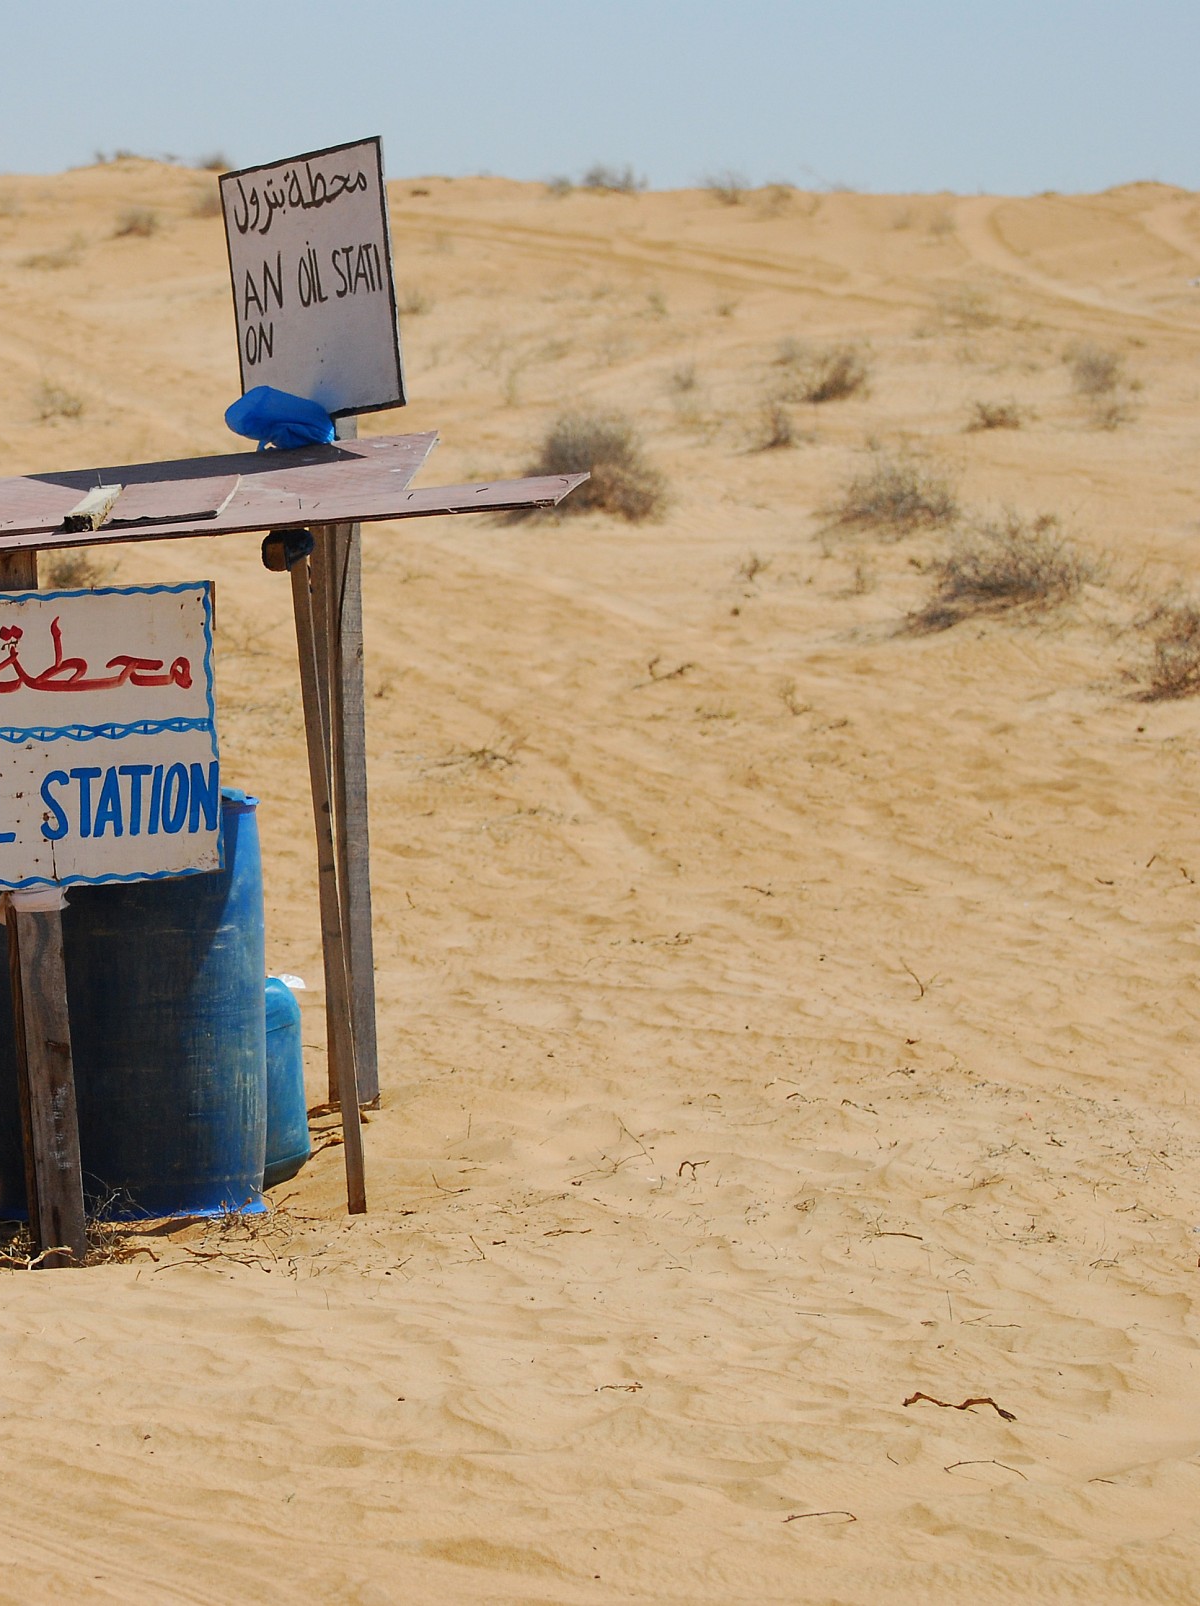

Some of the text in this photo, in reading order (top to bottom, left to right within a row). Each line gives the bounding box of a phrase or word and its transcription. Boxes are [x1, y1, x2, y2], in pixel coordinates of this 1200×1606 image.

[233, 161, 368, 236] محطة بترول
[244, 250, 283, 321] AN
[332, 243, 383, 299] STATI
[245, 322, 274, 366] ON
[40, 761, 219, 840] STATION
